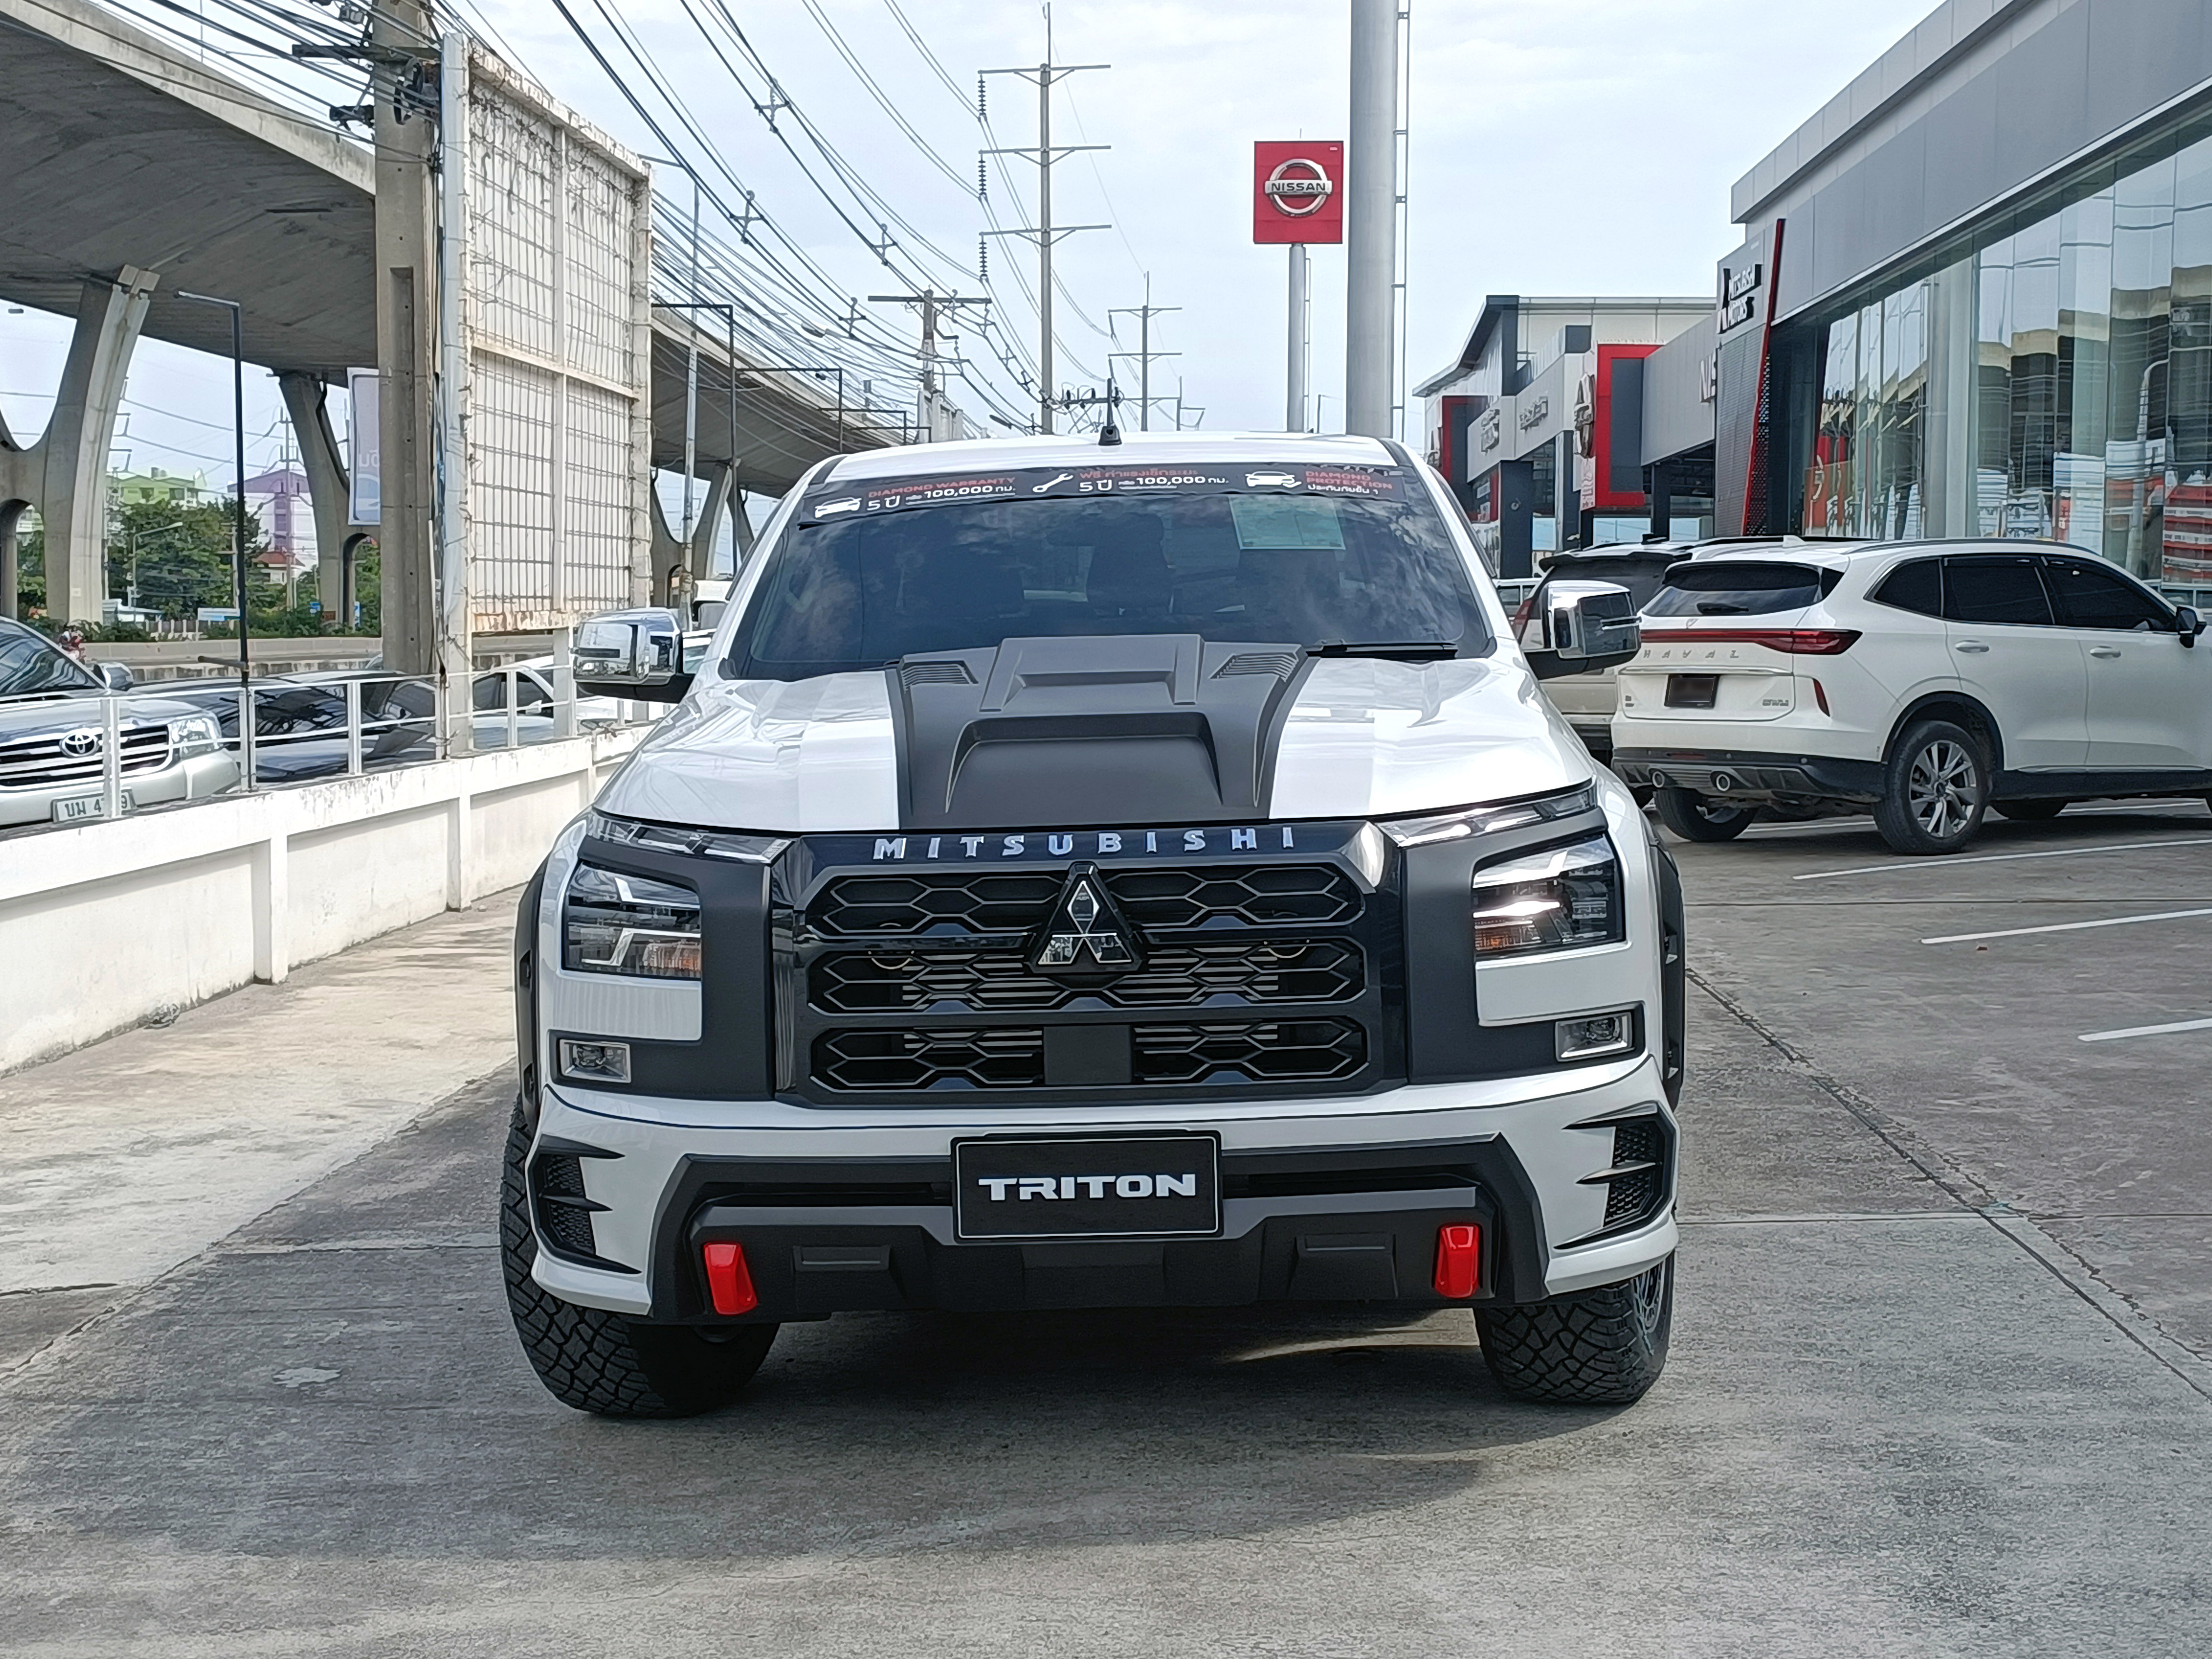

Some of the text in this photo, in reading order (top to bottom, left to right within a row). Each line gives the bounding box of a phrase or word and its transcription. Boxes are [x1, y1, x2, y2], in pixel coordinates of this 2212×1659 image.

[1271, 183, 1326, 191] NISSAN
[1079, 482, 1093, 492] 5
[1137, 476, 1206, 485] 100,000
[1305, 471, 1371, 481] DIAMOND
[1306, 477, 1393, 489] PROTECTION
[868, 484, 932, 498] DIAMOND
[936, 477, 1015, 488] WARRANTY
[867, 500, 881, 510] 5
[924, 485, 993, 498] 100,000
[873, 827, 1294, 860] MITSUBISHI
[978, 1173, 1196, 1201] TRITON
